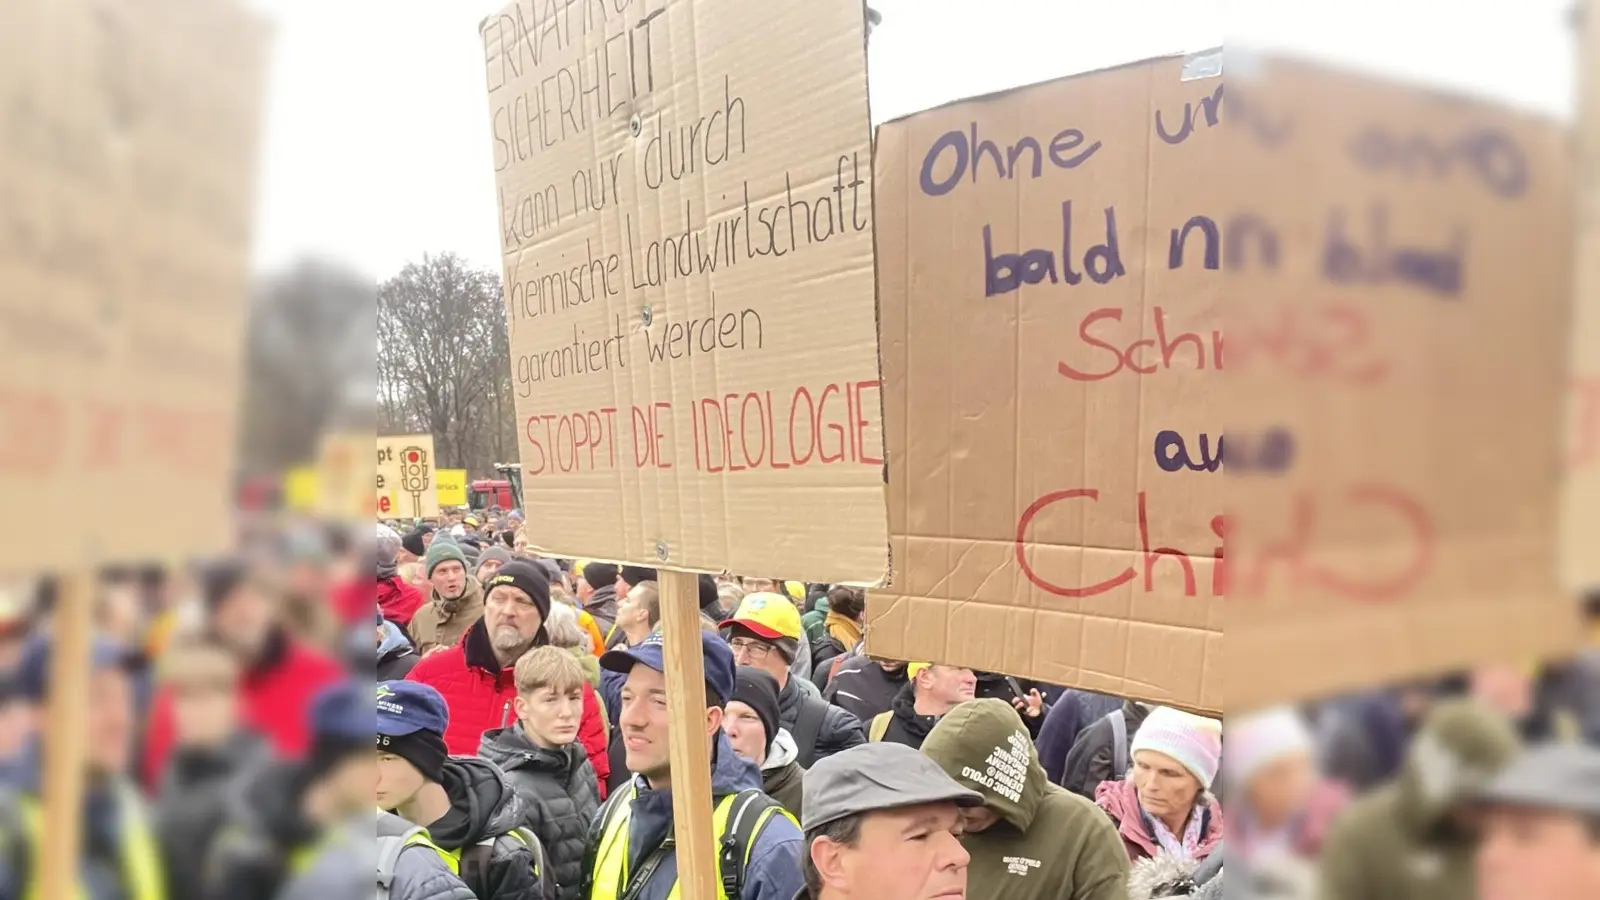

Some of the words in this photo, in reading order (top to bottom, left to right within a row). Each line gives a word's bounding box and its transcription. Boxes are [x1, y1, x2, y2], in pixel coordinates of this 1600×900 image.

[494, 8, 665, 172] SICHERHEIT
[500, 183, 560, 247] kann
[571, 151, 623, 218] nur
[644, 74, 746, 190] durch
[919, 121, 1102, 196] Ohne
[507, 239, 620, 321] heimische
[627, 151, 868, 290] Landwirtschaft
[984, 200, 1125, 298] bald
[517, 313, 625, 398] garantiert
[645, 293, 763, 363] werden
[1057, 306, 1223, 381] Sch
[526, 407, 618, 476] STOPPT
[631, 401, 673, 470] DIE
[691, 380, 883, 473] IDEOLOGIE
